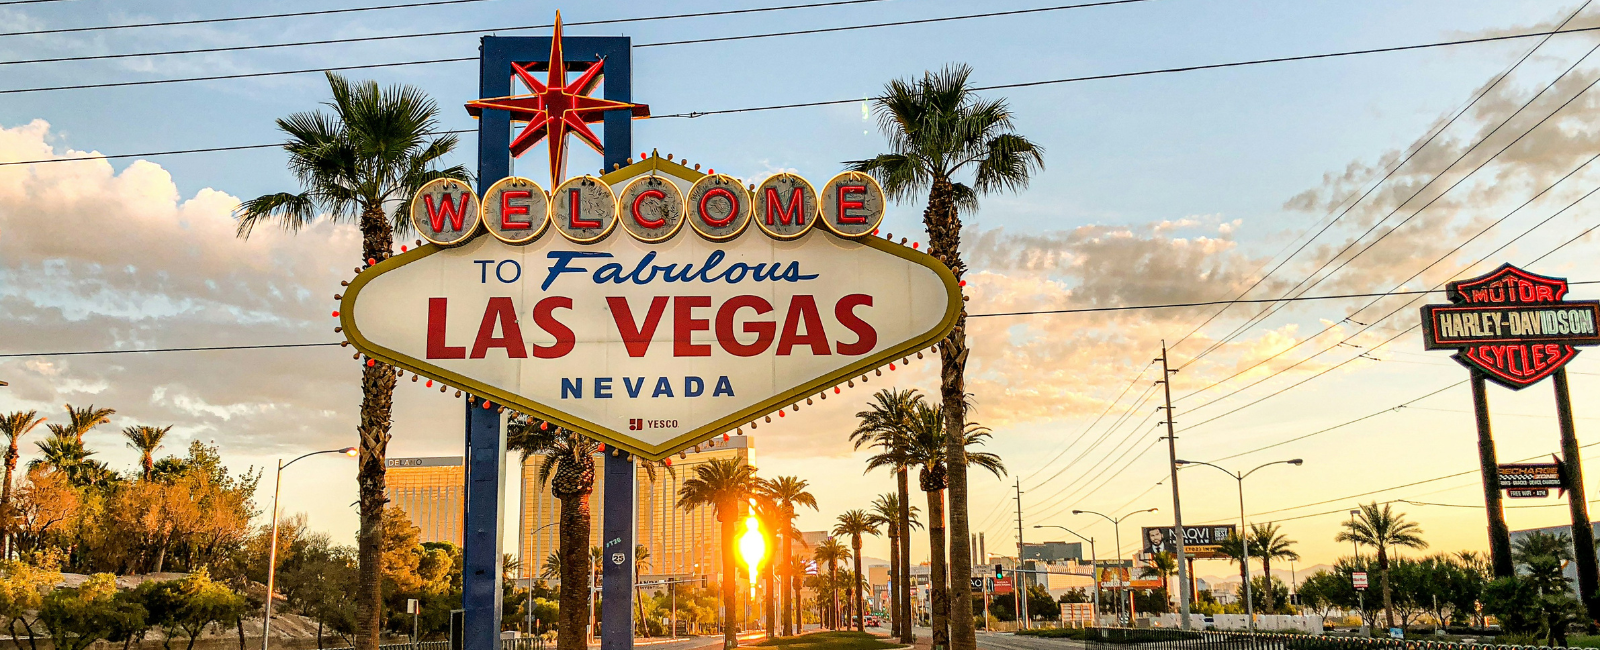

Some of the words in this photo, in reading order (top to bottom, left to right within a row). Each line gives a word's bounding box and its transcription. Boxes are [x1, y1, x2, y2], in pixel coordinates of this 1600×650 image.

[422, 184, 868, 233] WELCOME
[473, 259, 523, 284] TO
[540, 249, 820, 292] Fabulous
[1472, 275, 1554, 303] MOTOR
[425, 296, 577, 360] LAS
[605, 293, 879, 359] VEGAS
[1440, 309, 1594, 338] HARLEY-DAVIDSON
[1478, 344, 1562, 377] CYCLES
[560, 375, 736, 400] NEVADA
[647, 419, 679, 429] YESCO
[388, 458, 423, 467] DELANO
